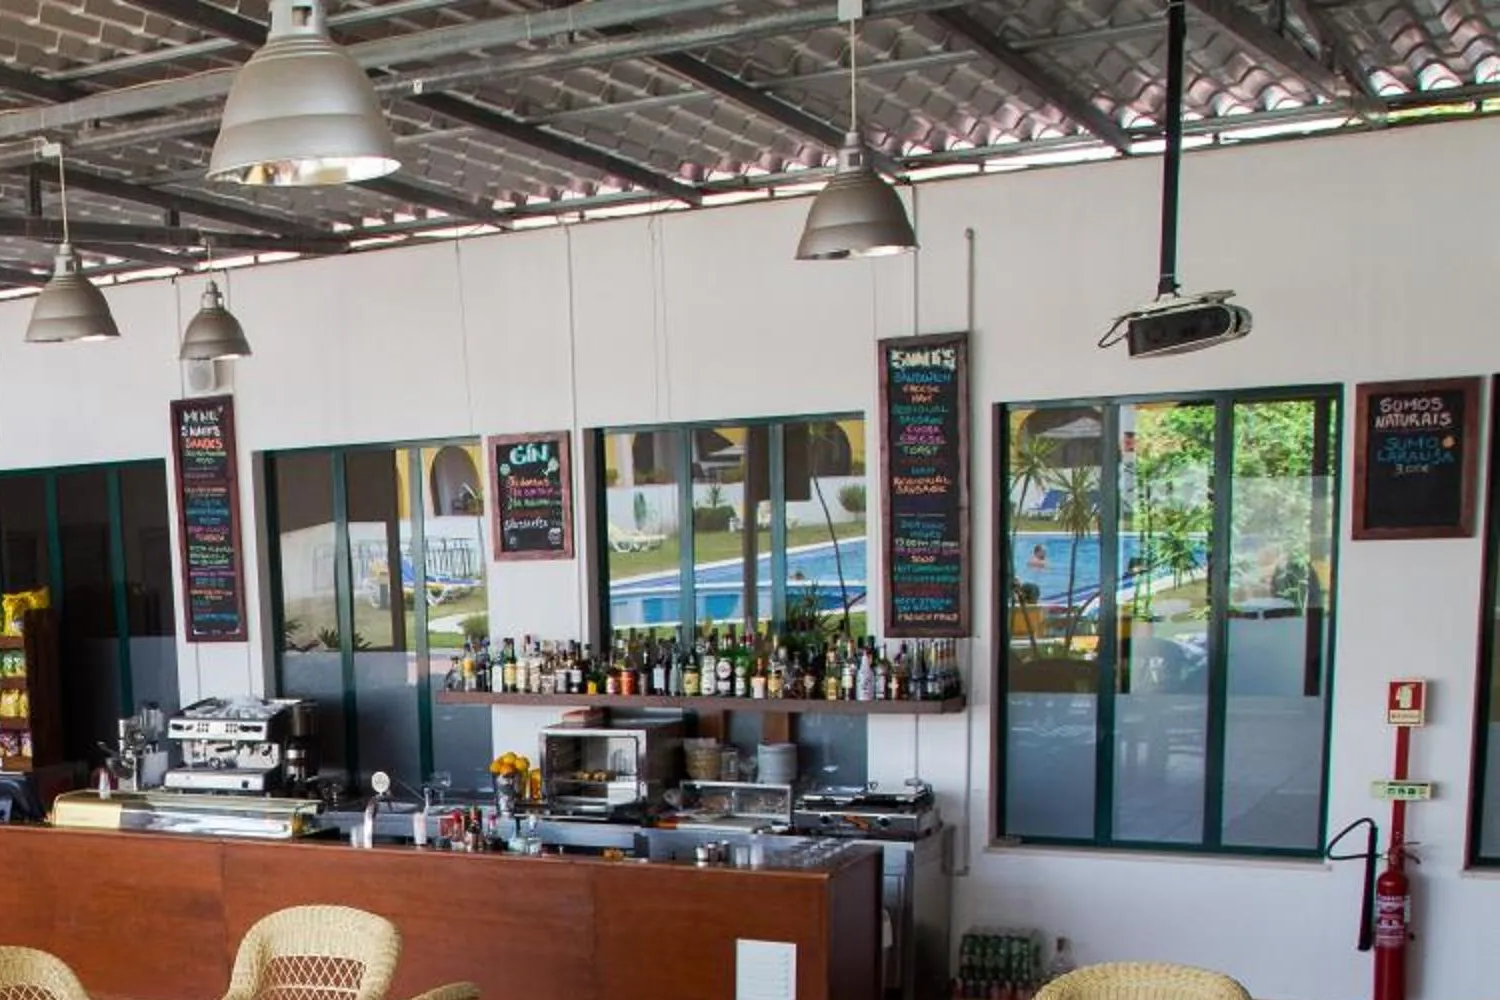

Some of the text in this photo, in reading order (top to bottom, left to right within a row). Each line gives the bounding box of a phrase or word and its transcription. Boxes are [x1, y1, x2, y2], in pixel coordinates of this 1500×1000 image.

[1380, 397, 1444, 413] SUMOS
[1375, 412, 1453, 428] NATURAIS
[1384, 436, 1439, 450] SUMO
[509, 443, 550, 465] GIN
